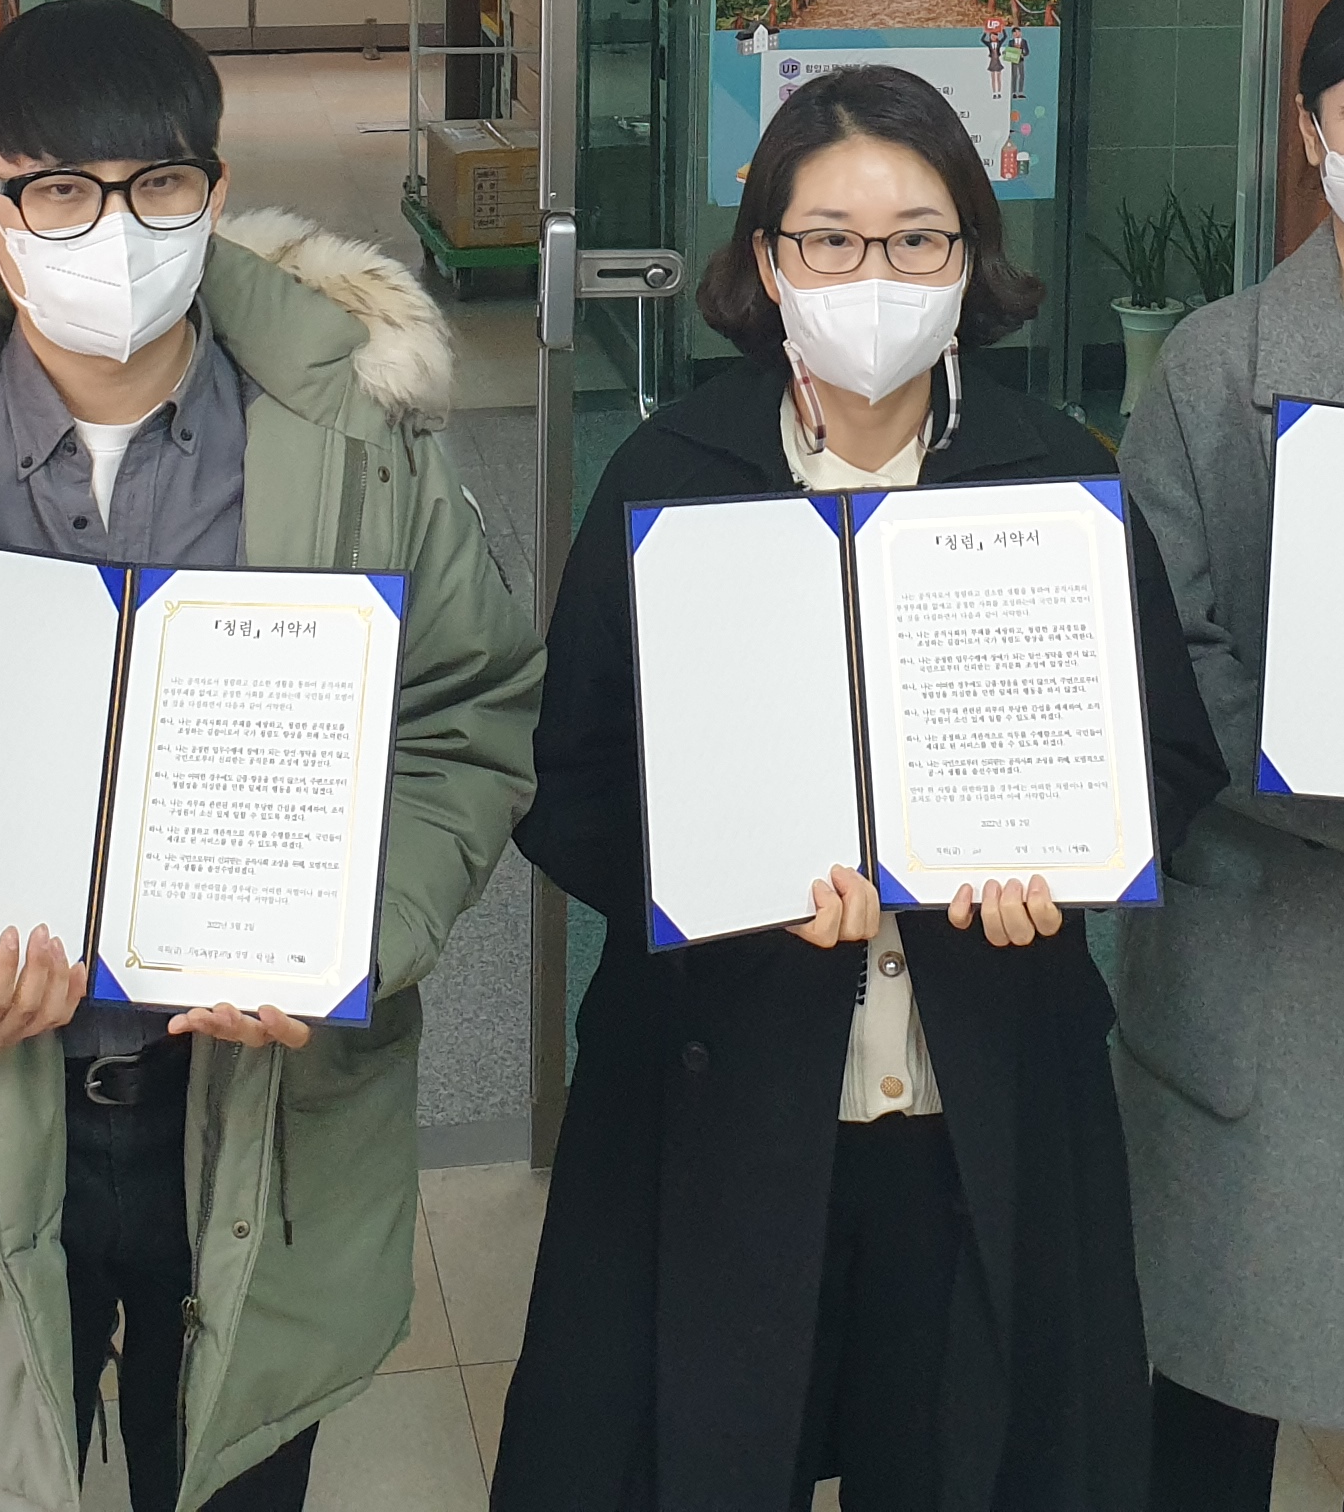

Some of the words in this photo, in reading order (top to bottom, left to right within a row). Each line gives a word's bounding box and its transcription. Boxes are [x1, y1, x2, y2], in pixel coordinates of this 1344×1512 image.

[987, 20, 1000, 29] UP
[782, 64, 798, 74] UP
[994, 529, 1039, 548] 서약서
[271, 620, 316, 638] 서약서
